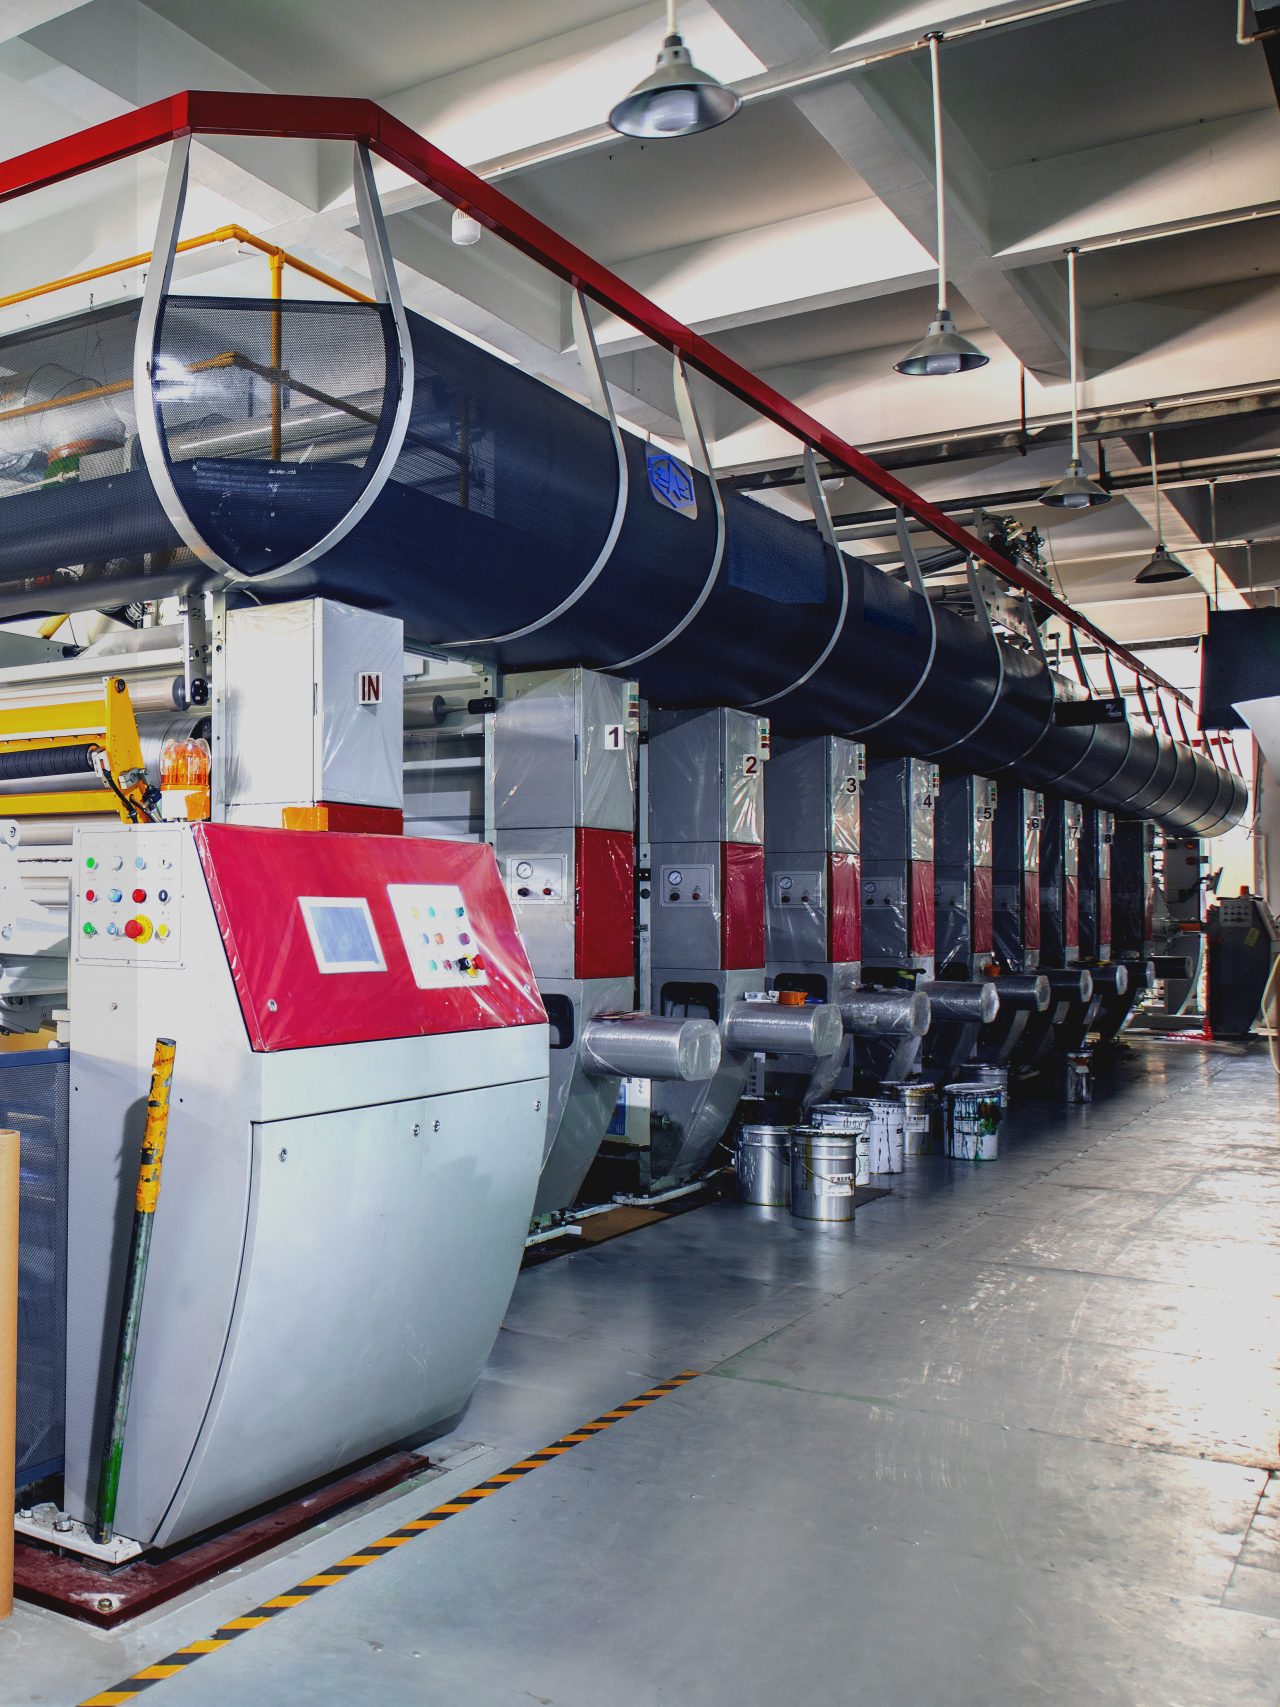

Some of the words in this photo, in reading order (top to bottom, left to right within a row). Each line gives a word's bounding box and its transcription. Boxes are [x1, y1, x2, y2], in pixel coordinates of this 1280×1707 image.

[361, 675, 380, 701] IN
[608, 726, 618, 747] 1
[745, 756, 757, 774] 2
[846, 777, 857, 793] 3
[923, 794, 932, 808] 4
[983, 807, 992, 820] 5
[1031, 818, 1039, 829] 6
[1071, 826, 1079, 837] 7
